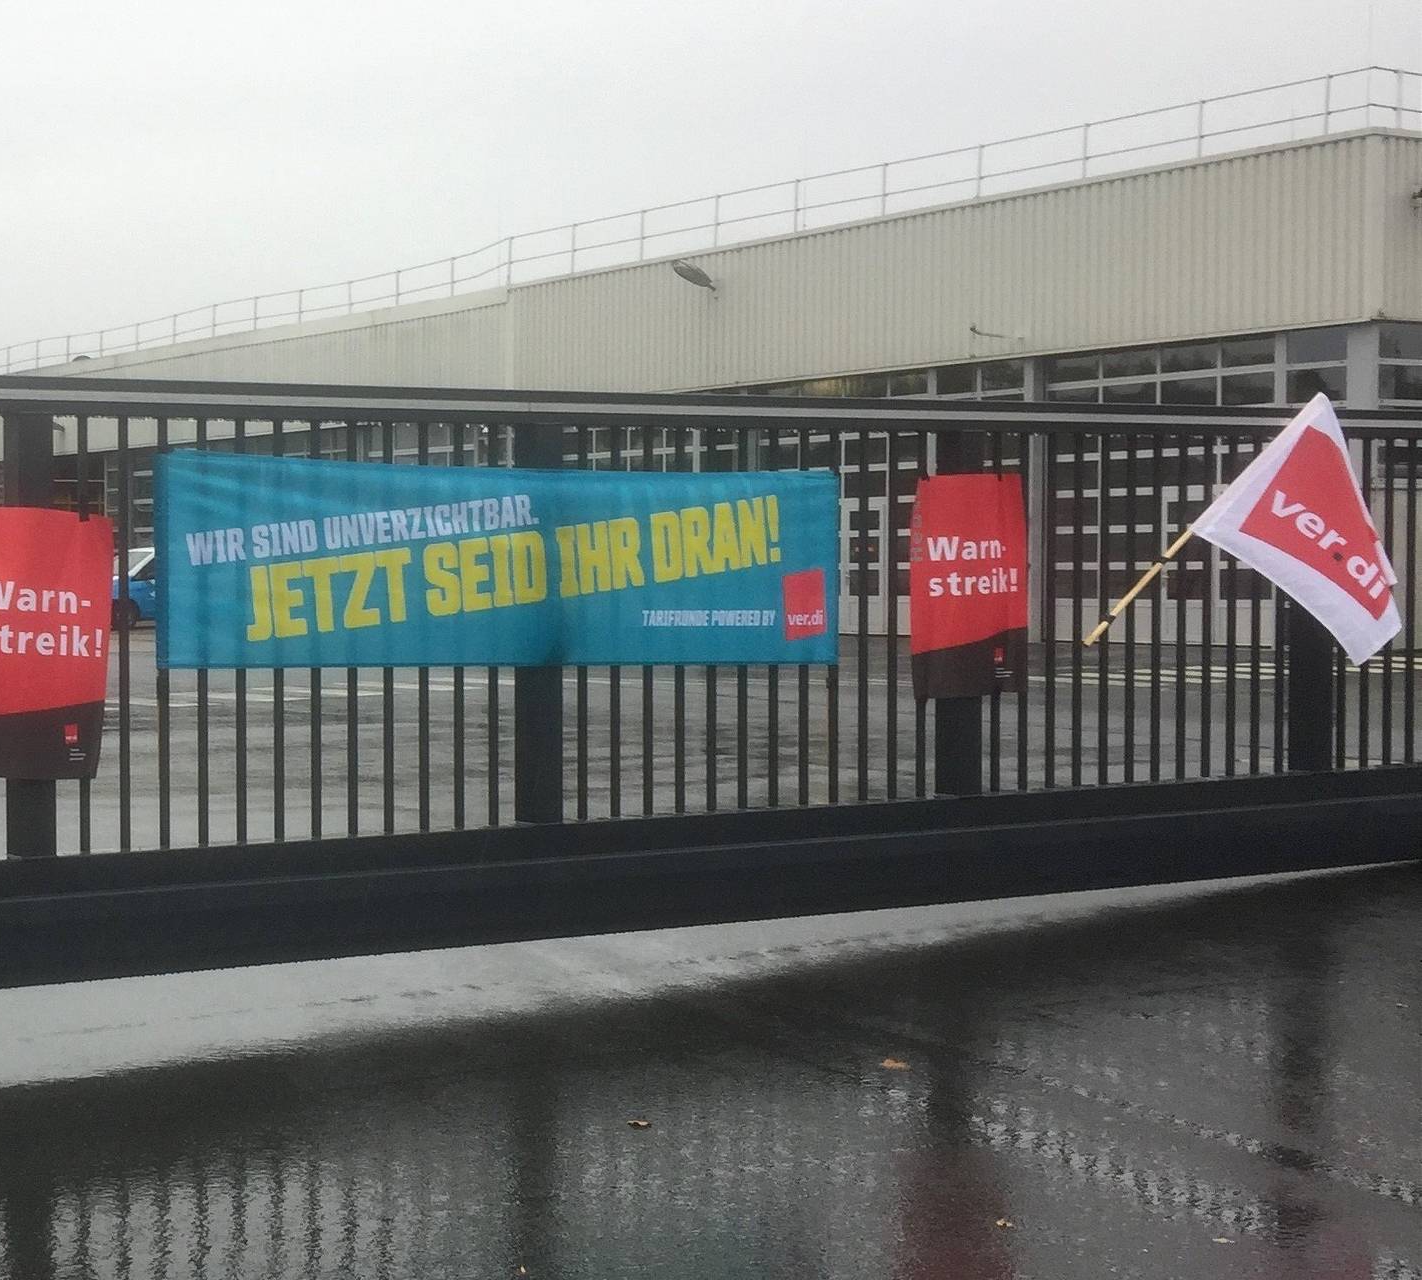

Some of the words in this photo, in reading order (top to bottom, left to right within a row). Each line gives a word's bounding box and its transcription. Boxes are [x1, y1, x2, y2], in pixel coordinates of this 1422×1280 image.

[186, 528, 246, 566] WIR
[251, 519, 318, 559] SIND
[323, 494, 540, 550] UNVERZICHTBAR.
[927, 536, 1007, 562] Warn-
[1270, 490, 1386, 601] ver.di
[246, 547, 411, 642] JETZT
[423, 530, 547, 617] SEID
[555, 517, 645, 598] IHR
[650, 494, 781, 583] DRAN!
[928, 567, 1019, 597] streik!
[711, 609, 760, 627] POWERED
[762, 609, 776, 627] BY
[786, 608, 825, 627] ver.di
